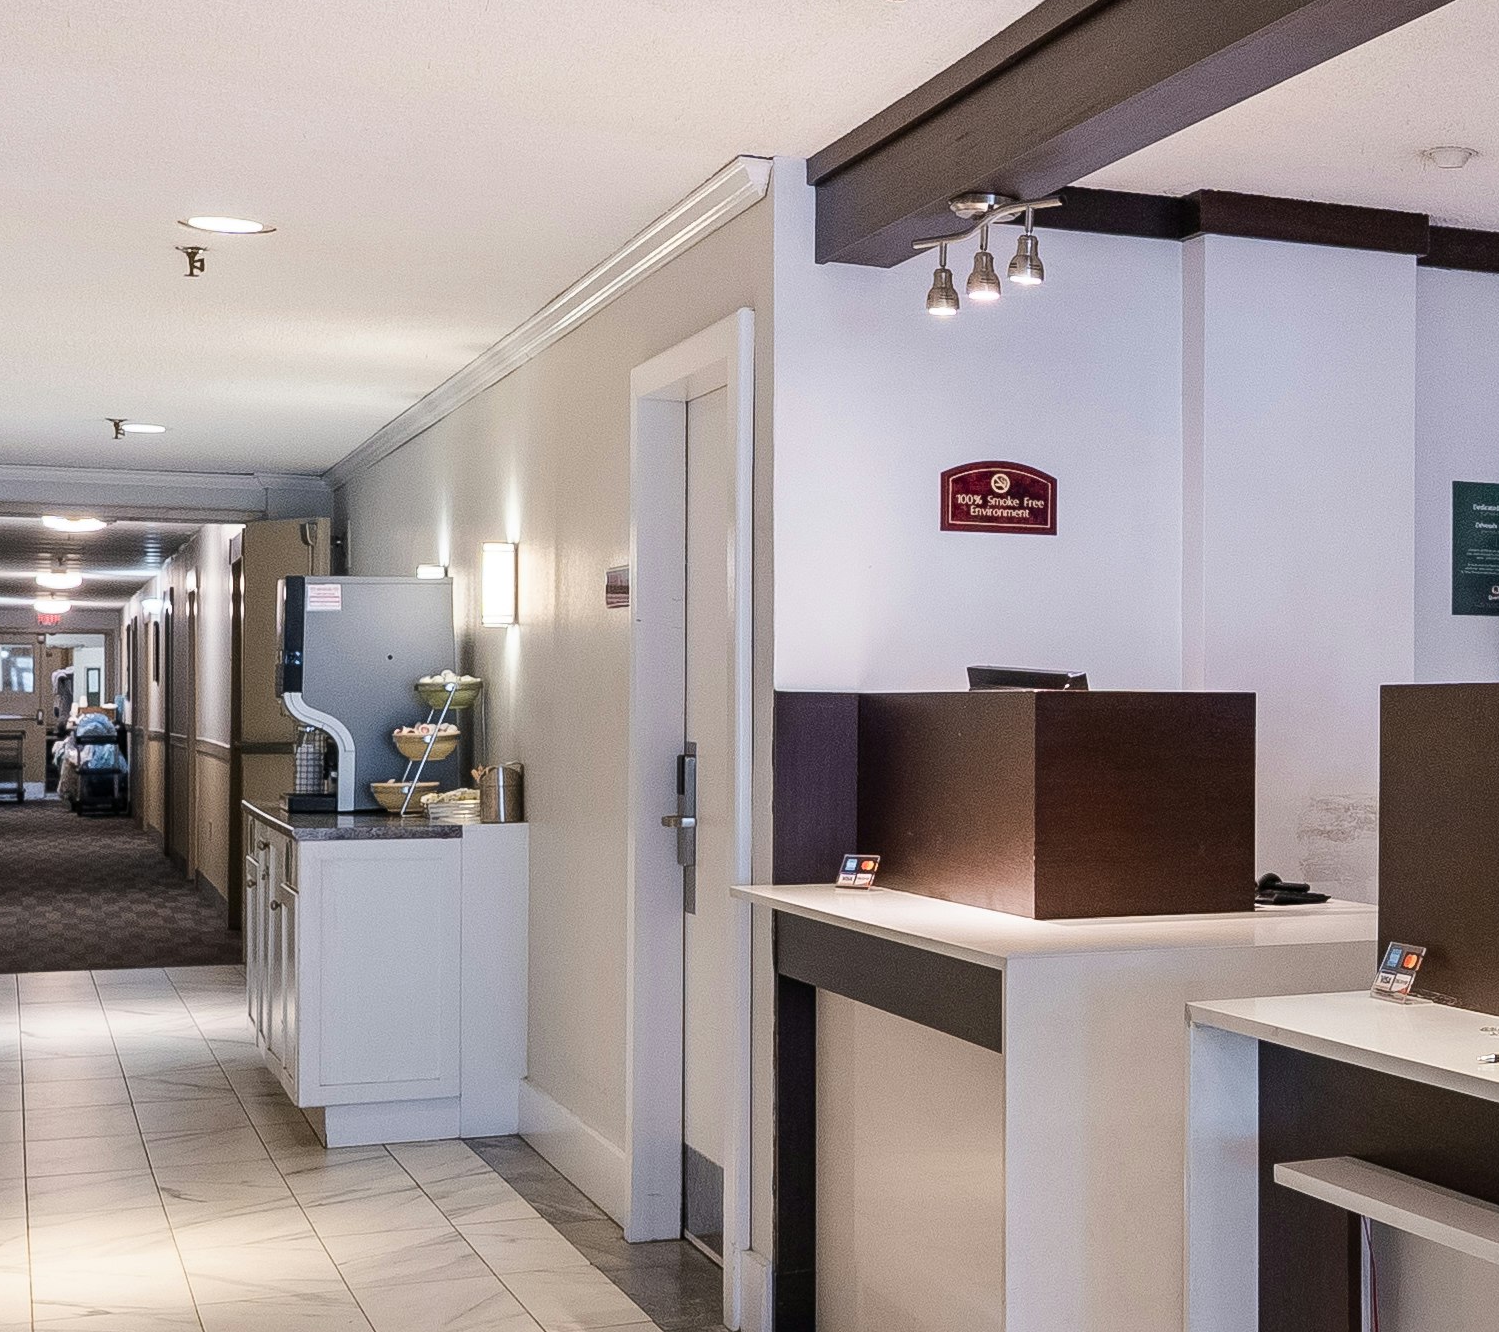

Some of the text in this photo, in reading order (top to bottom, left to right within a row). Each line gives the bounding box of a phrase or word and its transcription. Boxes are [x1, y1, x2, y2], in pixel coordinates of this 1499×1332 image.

[956, 494, 1045, 508] 100% Smoke Free
[970, 505, 1030, 518] Environment
